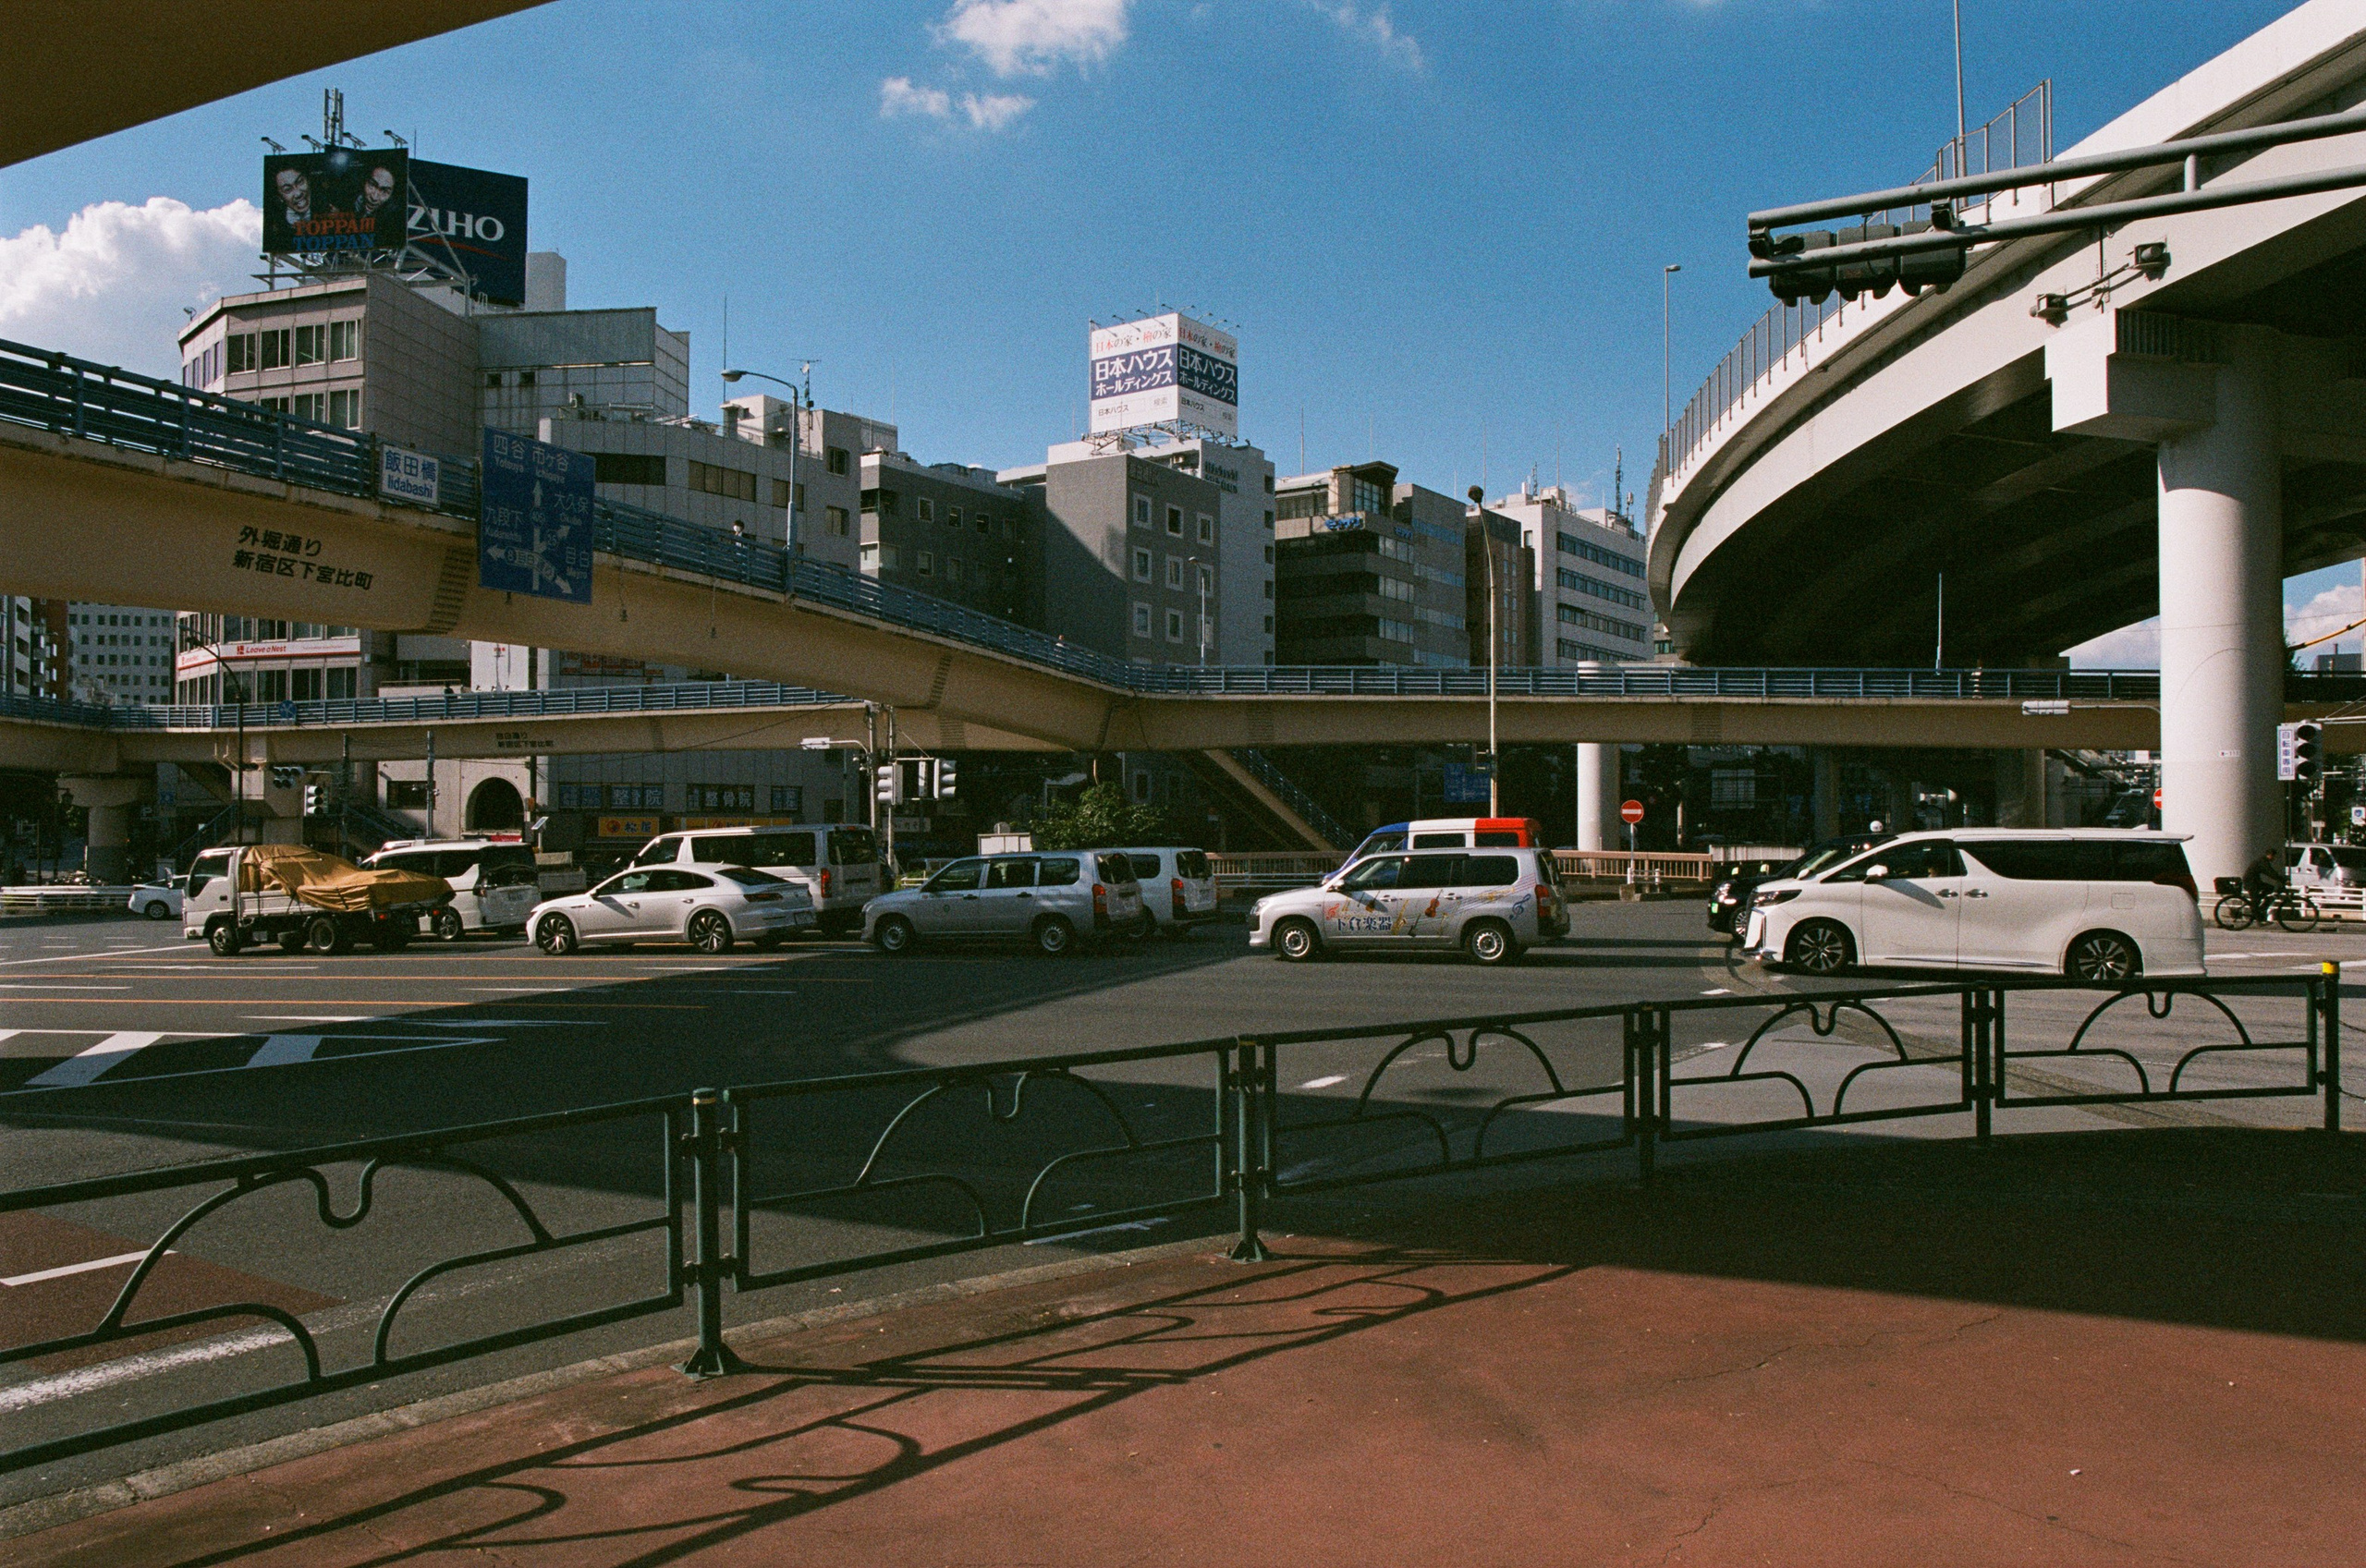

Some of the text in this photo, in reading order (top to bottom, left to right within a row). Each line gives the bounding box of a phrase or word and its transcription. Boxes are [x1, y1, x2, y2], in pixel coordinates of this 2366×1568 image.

[292, 234, 375, 252] TOPPAN
[1095, 348, 1174, 382] 日本ハウス
[1179, 347, 1236, 387] 日本ハウス
[1095, 371, 1173, 396] ホールディングス
[1179, 371, 1236, 404] ホールディングス
[1098, 405, 1129, 417] 日本ハウス
[494, 434, 525, 460] 四谷
[384, 450, 437, 482] 飯田橋
[387, 474, 433, 498] Iidabashi
[554, 492, 589, 515] 大久保
[485, 505, 523, 529] 九段下
[238, 525, 323, 557] 外堀通り
[233, 549, 374, 590] 新宿区下宮比町
[566, 546, 591, 568] 目白
[246, 646, 266, 654] Leave
